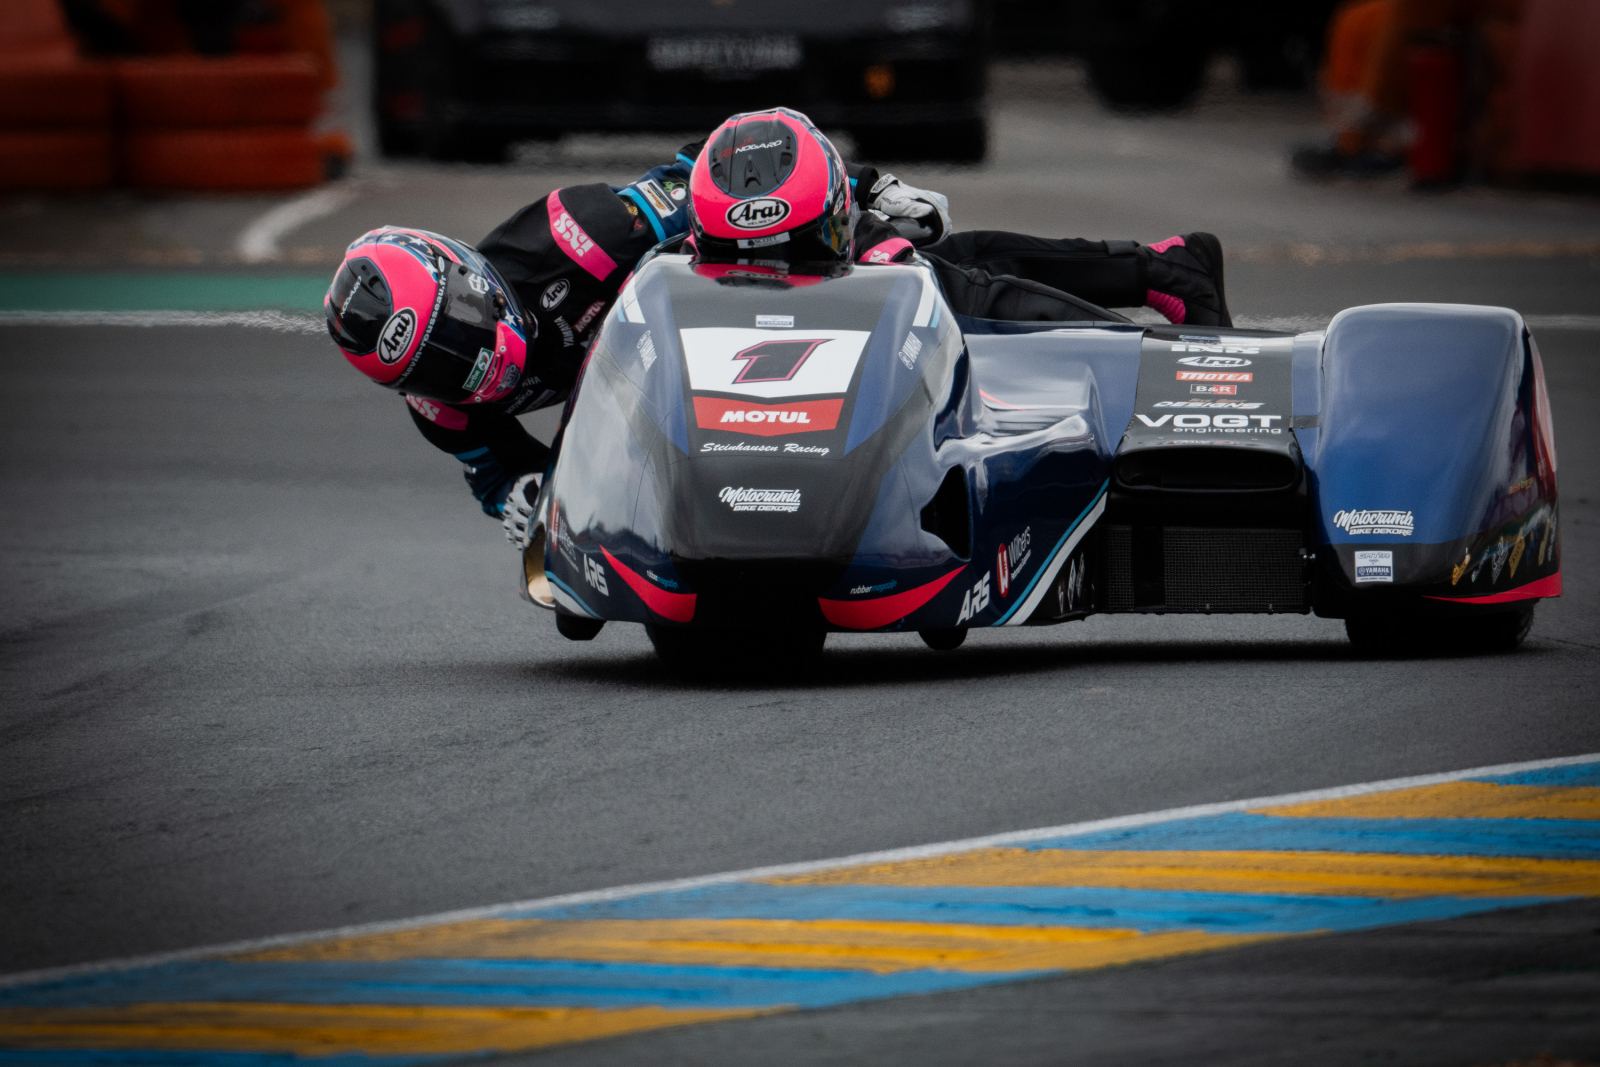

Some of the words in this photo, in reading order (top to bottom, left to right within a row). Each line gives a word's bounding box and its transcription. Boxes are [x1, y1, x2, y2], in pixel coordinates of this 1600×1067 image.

[735, 140, 783, 154] NOGARO
[732, 201, 782, 222] Arai
[546, 283, 567, 309] Arai
[382, 313, 411, 362] Arai
[731, 339, 835, 384] 1
[1177, 356, 1247, 366] Arai
[1152, 401, 1265, 410] DESIGNS
[720, 410, 811, 424] MOTUL
[1135, 414, 1281, 428] VOGT
[1173, 427, 1281, 435] engineering
[700, 442, 778, 453] Steinhausen
[783, 443, 831, 457] Racing
[757, 505, 800, 513] DEKORE
[1348, 528, 1372, 536] BIKE
[1373, 528, 1413, 537] DEKORE
[583, 553, 610, 597] ARS
[954, 570, 991, 626] ARS
